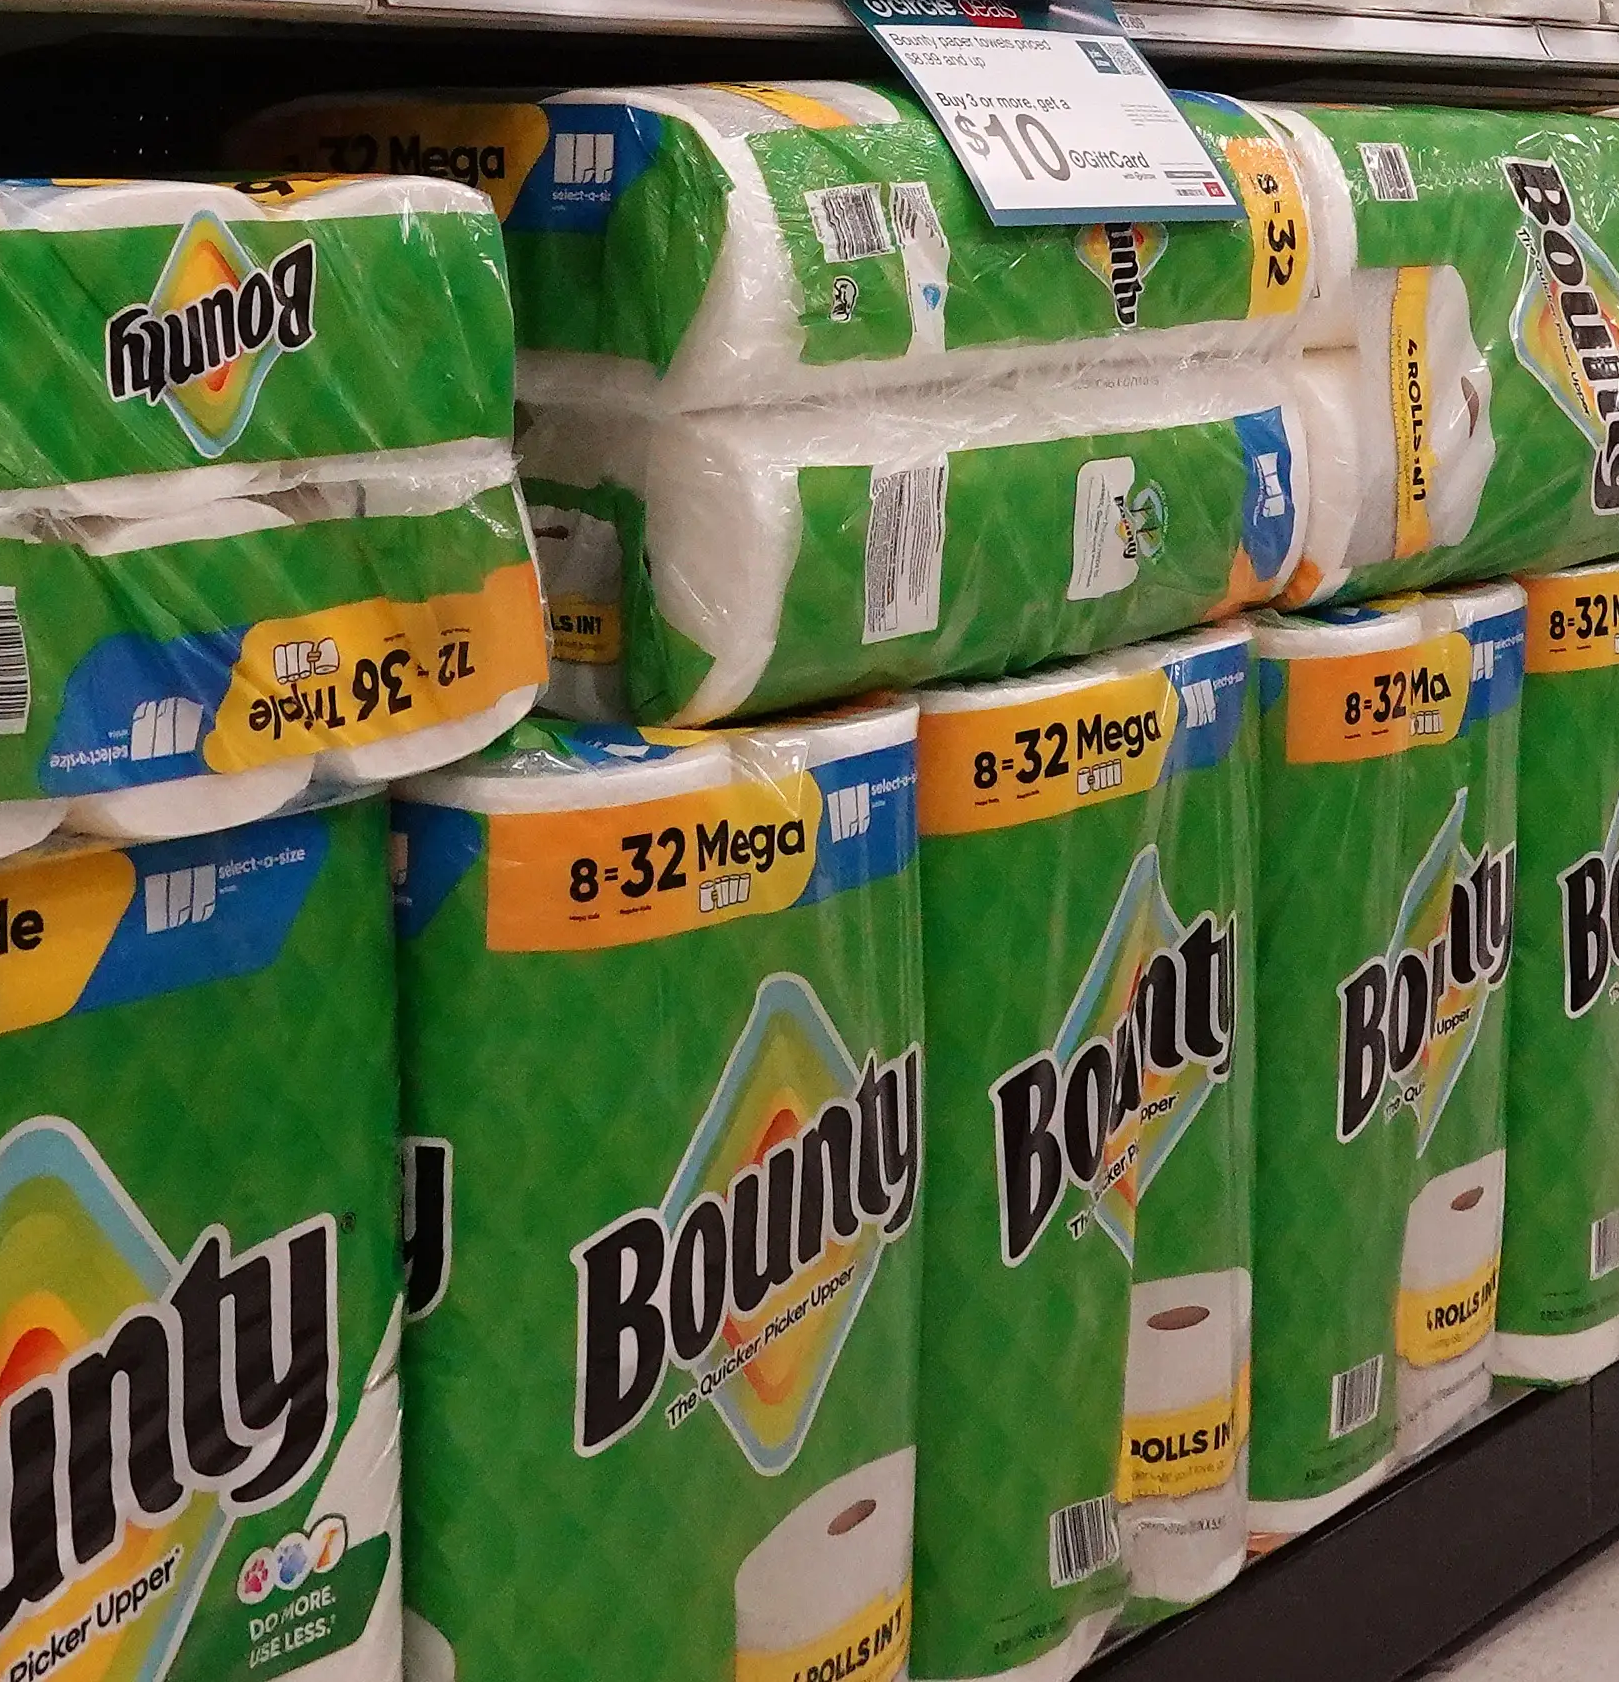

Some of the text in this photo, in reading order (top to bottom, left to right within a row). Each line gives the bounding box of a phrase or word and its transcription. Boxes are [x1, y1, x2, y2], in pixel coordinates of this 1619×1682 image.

[889, 33, 1051, 53] Bounty paper towels priced
[905, 52, 986, 69] $8.99 and up
[936, 92, 1071, 113] Buy 3 or more, get a
[389, 132, 504, 187] Mega
[954, 110, 1071, 182] $10
[1085, 151, 1150, 170] GiftCard
[111, 239, 315, 402] Bounty
[249, 682, 344, 740] Triple
[1076, 708, 1163, 759] Mega
[48, 742, 129, 771] select-a-size
[217, 844, 306, 881] select-a-size
[696, 818, 806, 873] Mega
[1436, 1006, 1471, 1037] Upper
[583, 1052, 919, 1453] Bounty
[1432, 1292, 1477, 1331] ROLLS
[668, 1265, 852, 1426] The Quicker Picker Upper
[9, 1552, 176, 1682] Picker Upper
[249, 1584, 336, 1642] DO MORE.
[250, 1618, 332, 1670] USE LESS.
